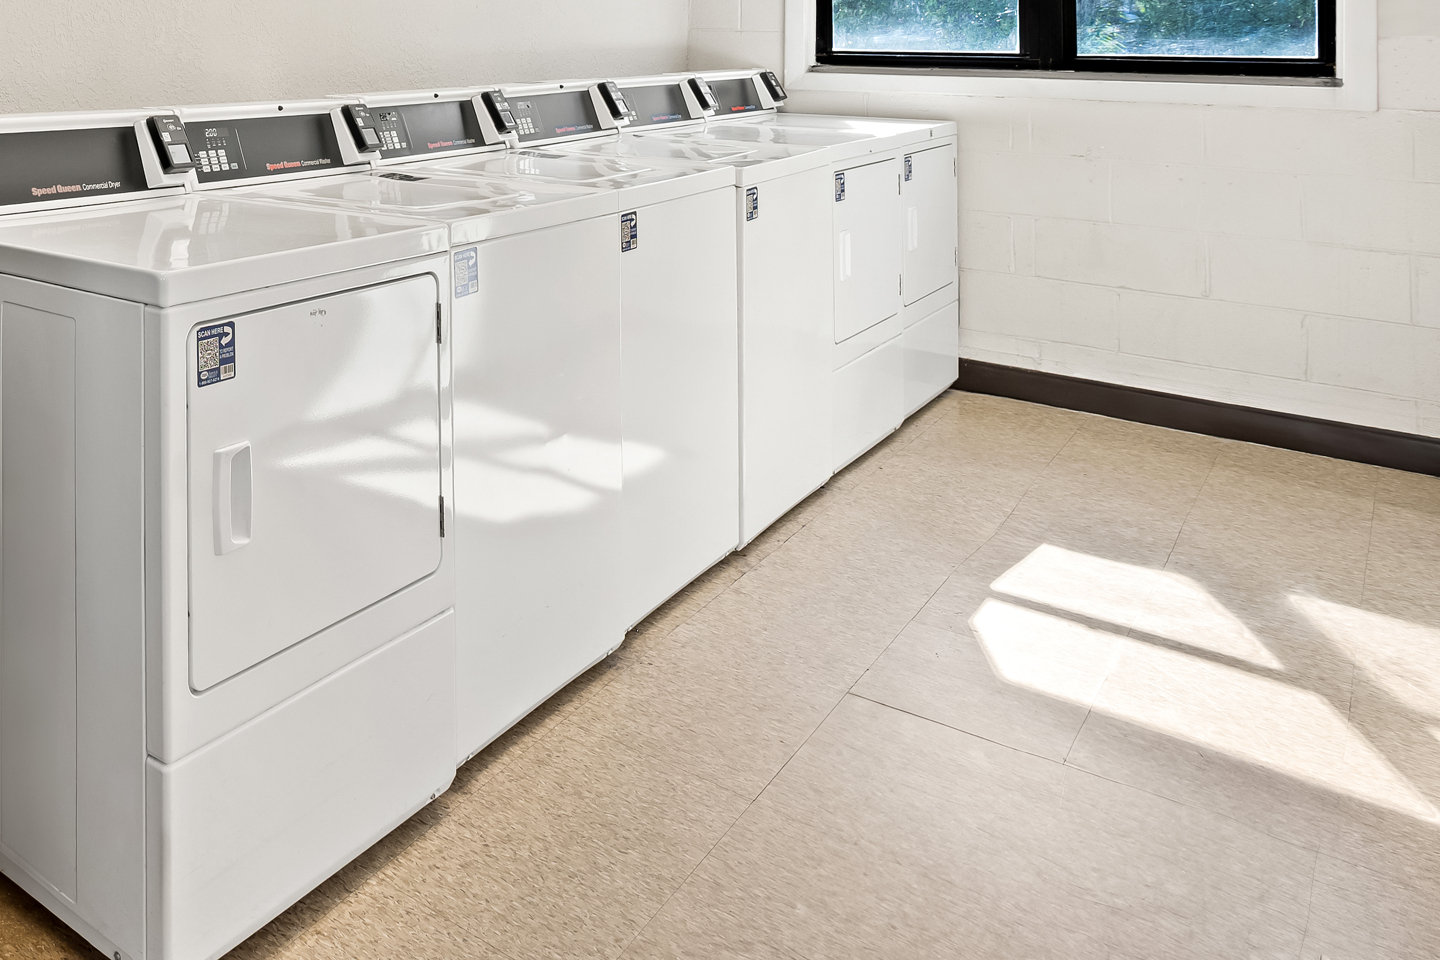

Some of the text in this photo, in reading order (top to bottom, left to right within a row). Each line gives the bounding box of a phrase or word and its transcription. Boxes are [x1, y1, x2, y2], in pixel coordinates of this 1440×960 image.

[266, 162, 283, 171] Speed
[31, 180, 121, 197] Speed Queen Commercial Dryer
[198, 327, 223, 339] SCAN HERE
